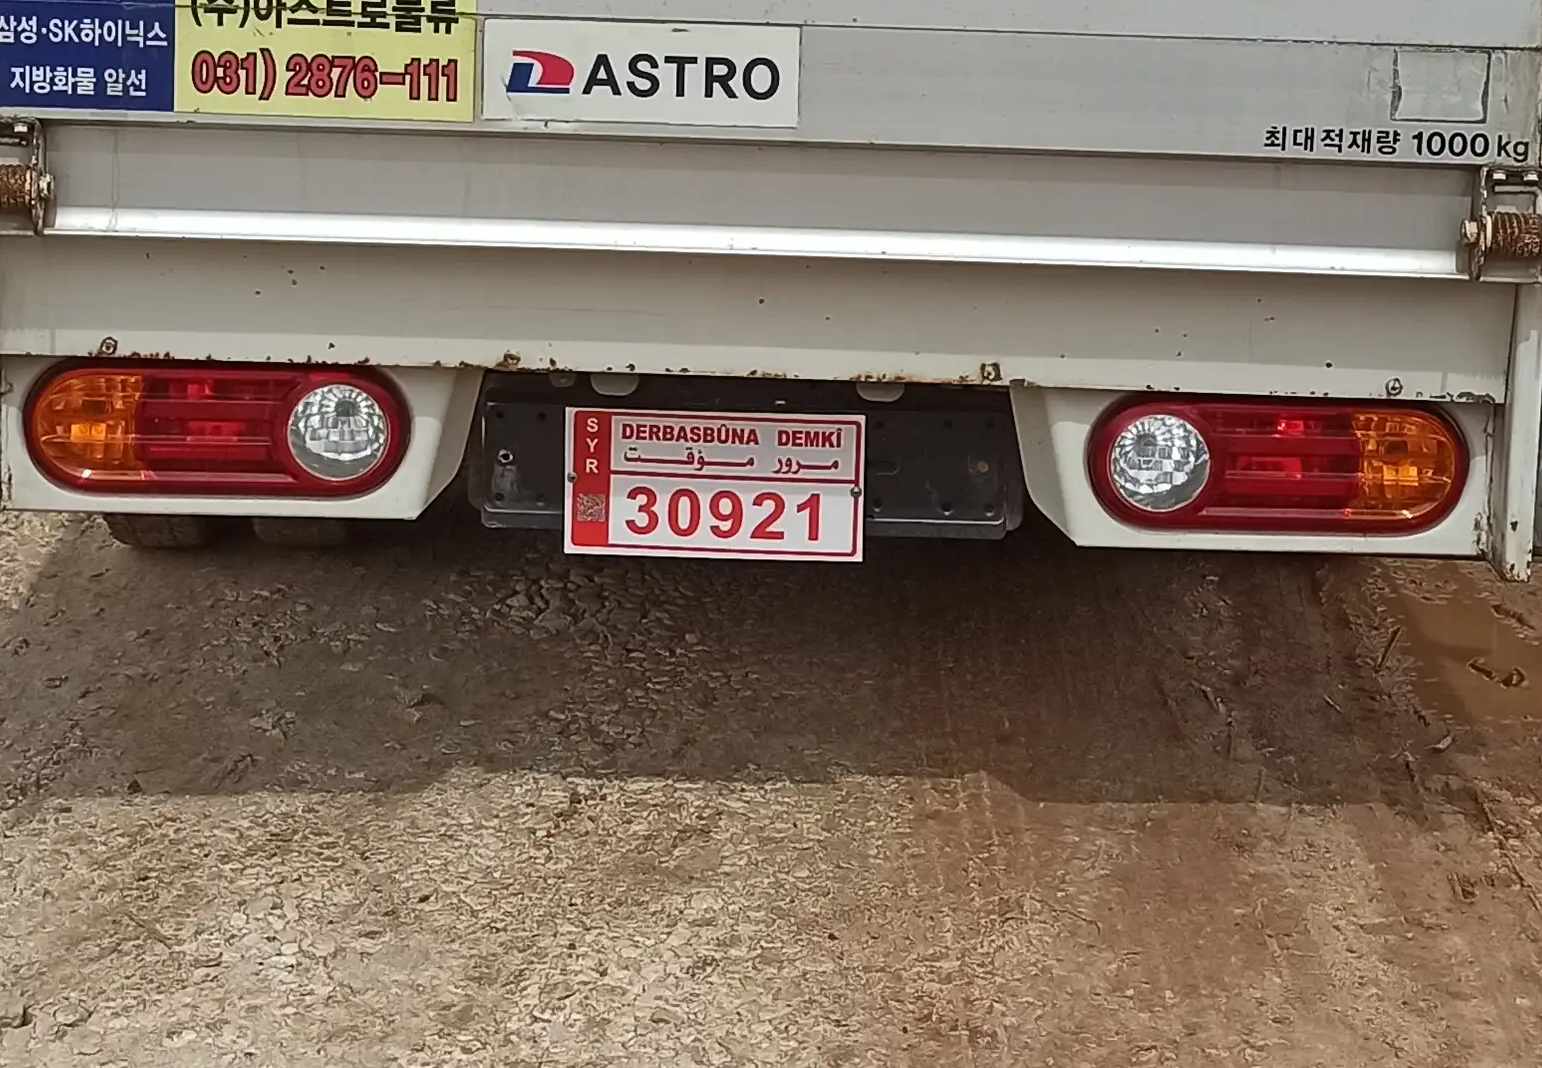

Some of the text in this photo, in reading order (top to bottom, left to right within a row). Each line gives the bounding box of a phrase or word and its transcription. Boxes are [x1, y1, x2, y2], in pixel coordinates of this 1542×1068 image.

[10, 65, 147, 97] 지방화물 알선
[192, 49, 458, 102] 031) 2876-111
[581, 53, 780, 100] ASTRO
[1264, 126, 1401, 155] 최대적재량
[621, 423, 842, 448] DERBASBÛNA DEMKÎ
[772, 457, 839, 474] مرور
[625, 486, 821, 542] 30921
